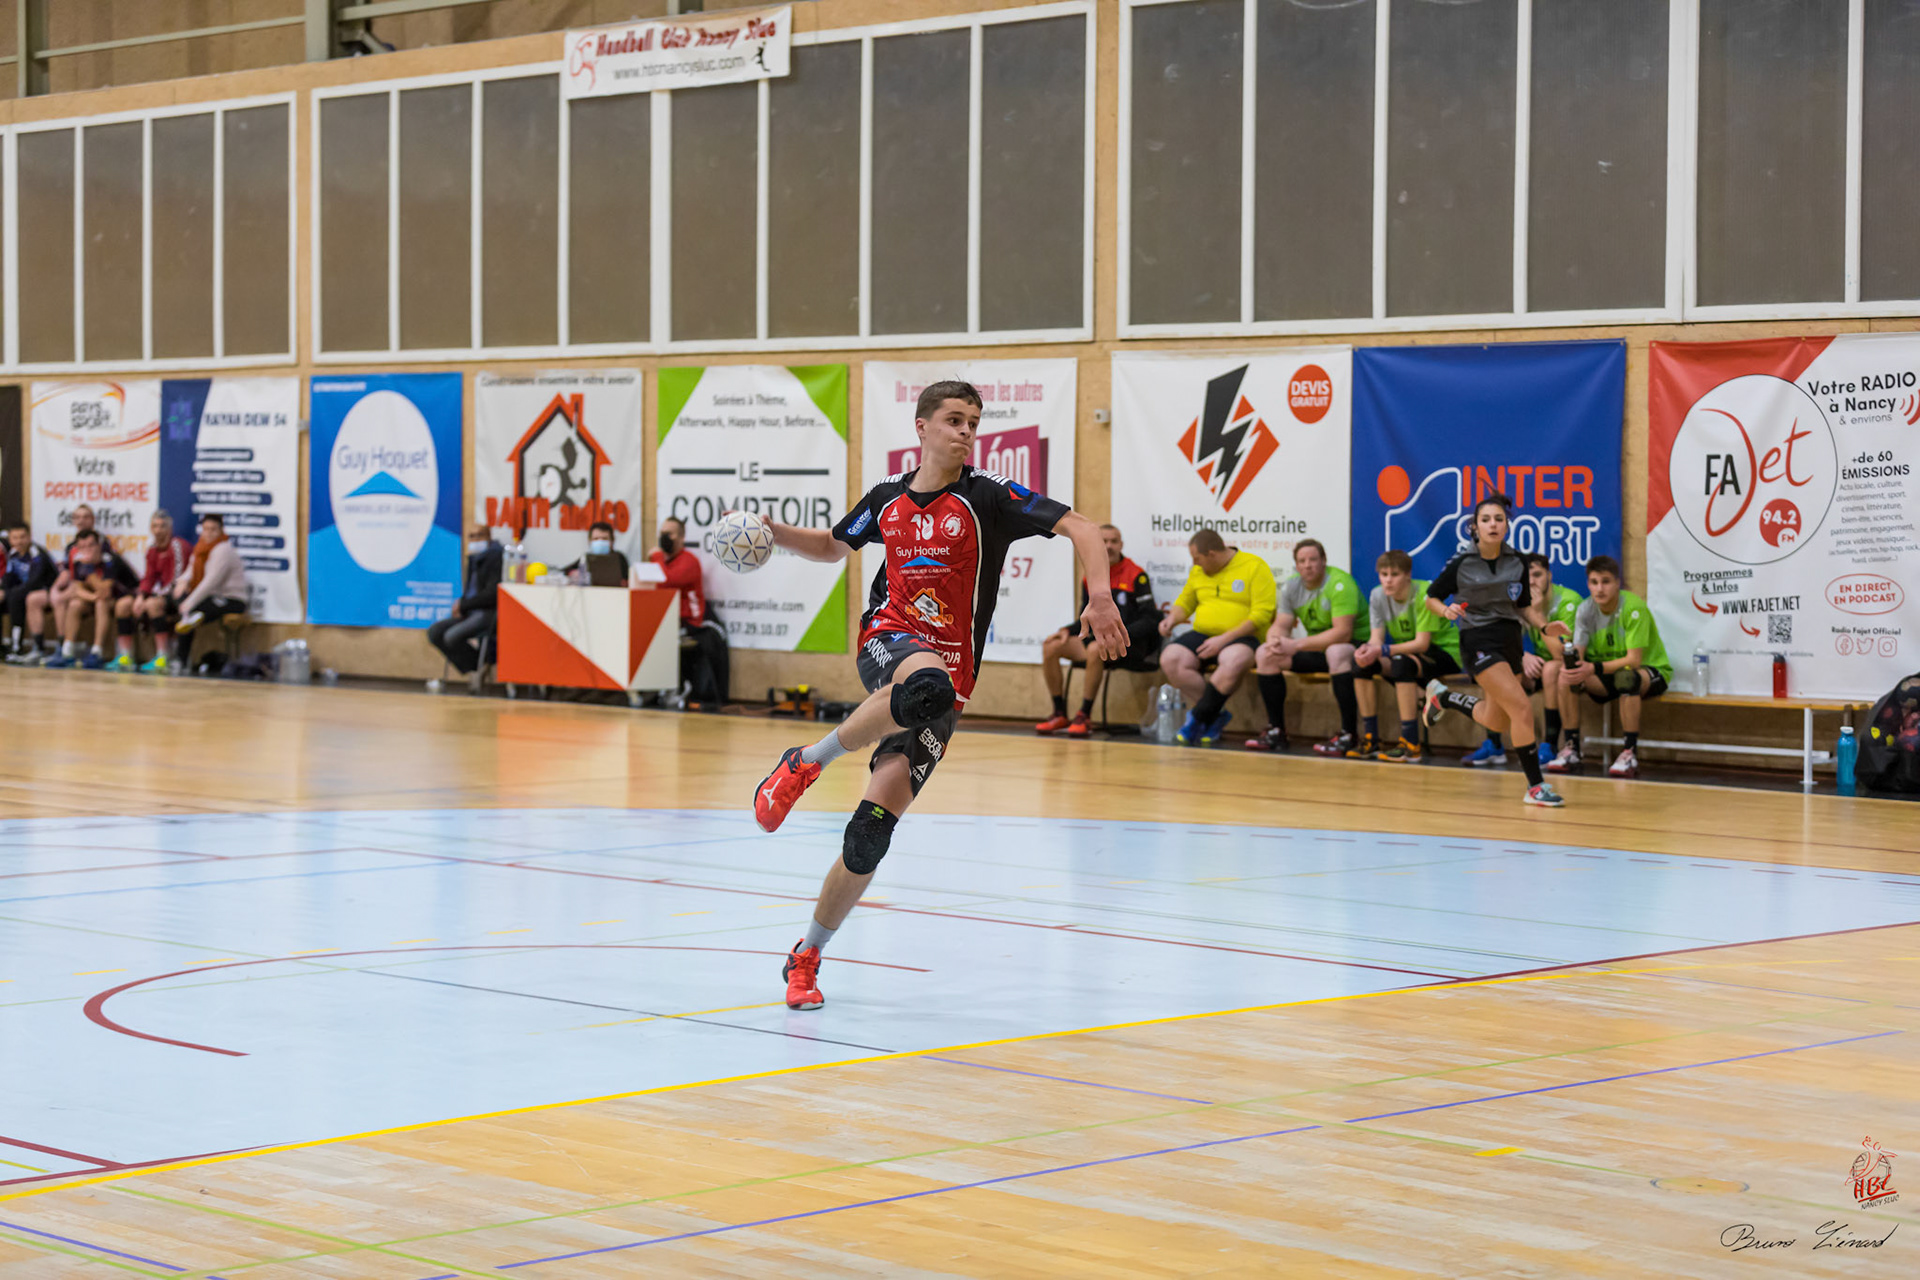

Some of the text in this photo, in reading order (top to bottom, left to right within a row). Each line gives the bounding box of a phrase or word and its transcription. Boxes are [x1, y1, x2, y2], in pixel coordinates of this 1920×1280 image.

[1291, 380, 1330, 395] DEVIS
[1807, 371, 1917, 397] Votre RADIO
[1291, 396, 1328, 407] GRATUIT
[1829, 397, 1897, 413] à Nancy
[1839, 413, 1893, 425] & environs
[336, 445, 429, 473] Guy Hoquet
[1877, 450, 1893, 462] 60
[74, 456, 115, 475] Votre
[739, 462, 759, 482] LE
[1841, 464, 1910, 480] ÉMISSIONS
[45, 482, 149, 502] PARTENAIRE
[1462, 465, 1594, 508] INTER
[671, 495, 832, 529] COMPTOIR
[1762, 509, 1797, 525] 94.2
[1151, 514, 1308, 534] HelloHomeLorraine
[1456, 514, 1601, 566] SORT
[1781, 533, 1795, 544] FM
[895, 545, 951, 558] Guy Hoquet
[1684, 568, 1753, 582] Programmes
[1701, 581, 1739, 593] & Infos
[1839, 582, 1892, 594] EN DIRECT
[1722, 595, 1801, 615] WWW.FAJET.NET
[1834, 593, 1896, 605] EN PODCAST
[1831, 626, 1902, 636] Radio Fajet Officiel
